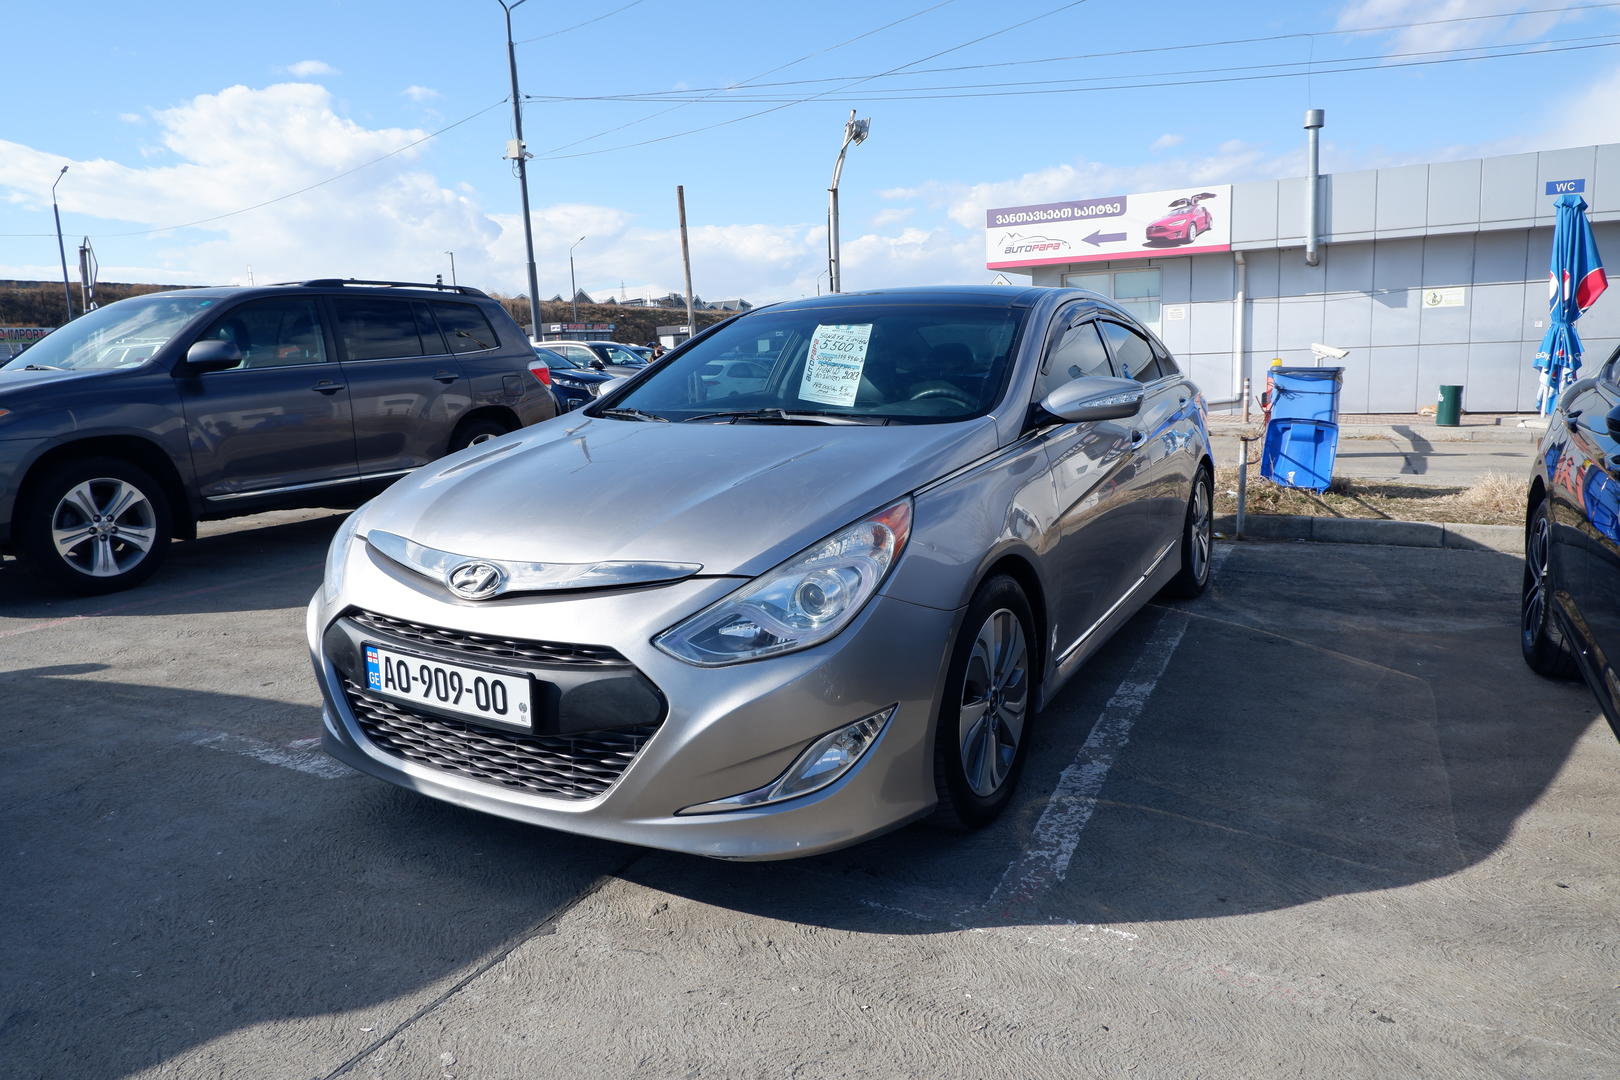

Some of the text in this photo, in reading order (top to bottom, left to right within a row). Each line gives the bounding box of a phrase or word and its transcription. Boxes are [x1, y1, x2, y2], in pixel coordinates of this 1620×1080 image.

[1556, 182, 1575, 192] WC
[1074, 203, 1120, 216] საიტზე
[368, 671, 381, 686] GE
